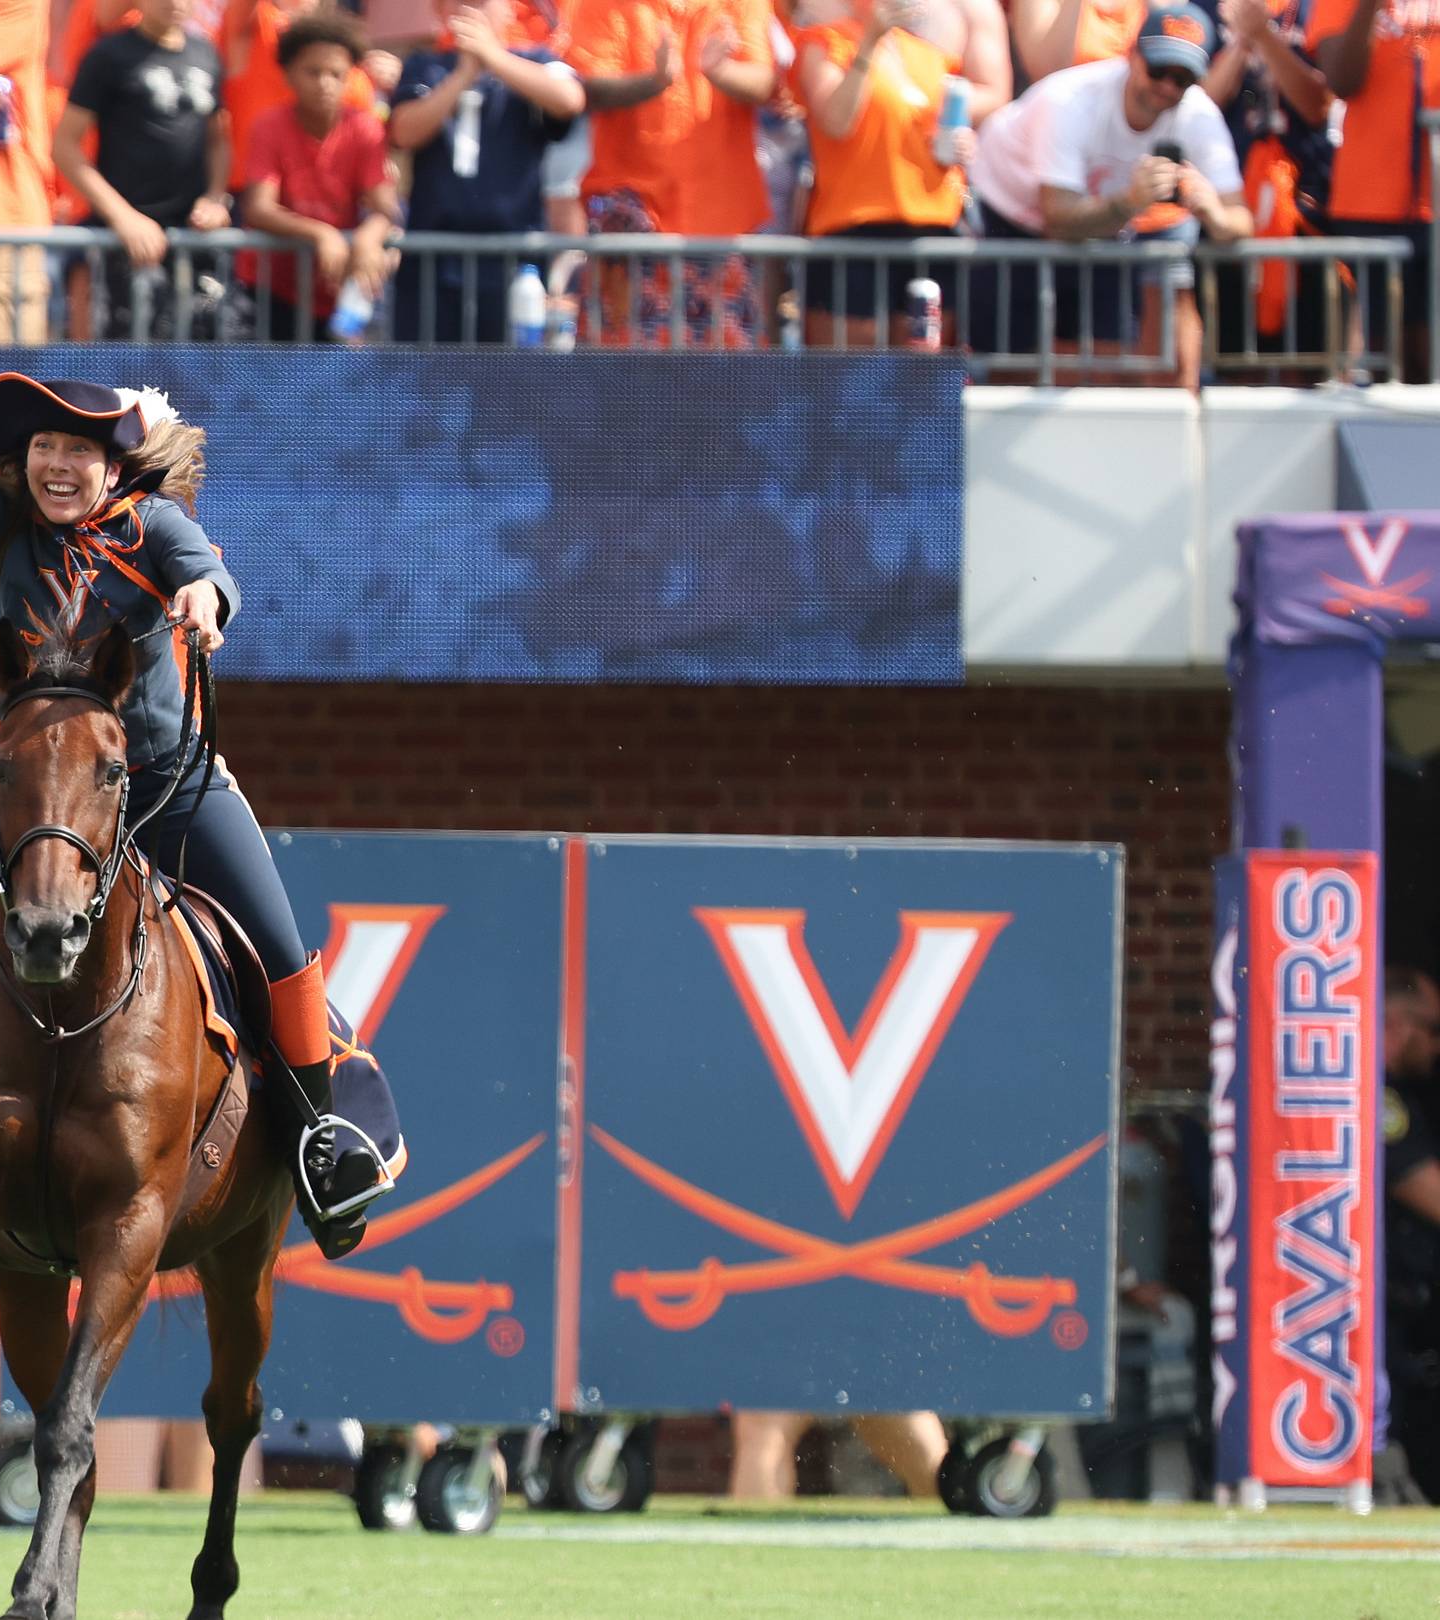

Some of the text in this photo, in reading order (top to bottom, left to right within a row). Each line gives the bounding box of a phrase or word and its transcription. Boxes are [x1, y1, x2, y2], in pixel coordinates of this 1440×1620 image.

[1339, 515, 1413, 586] V
[692, 905, 1014, 1221] V
[1270, 866, 1363, 1474] CAVALIERS
